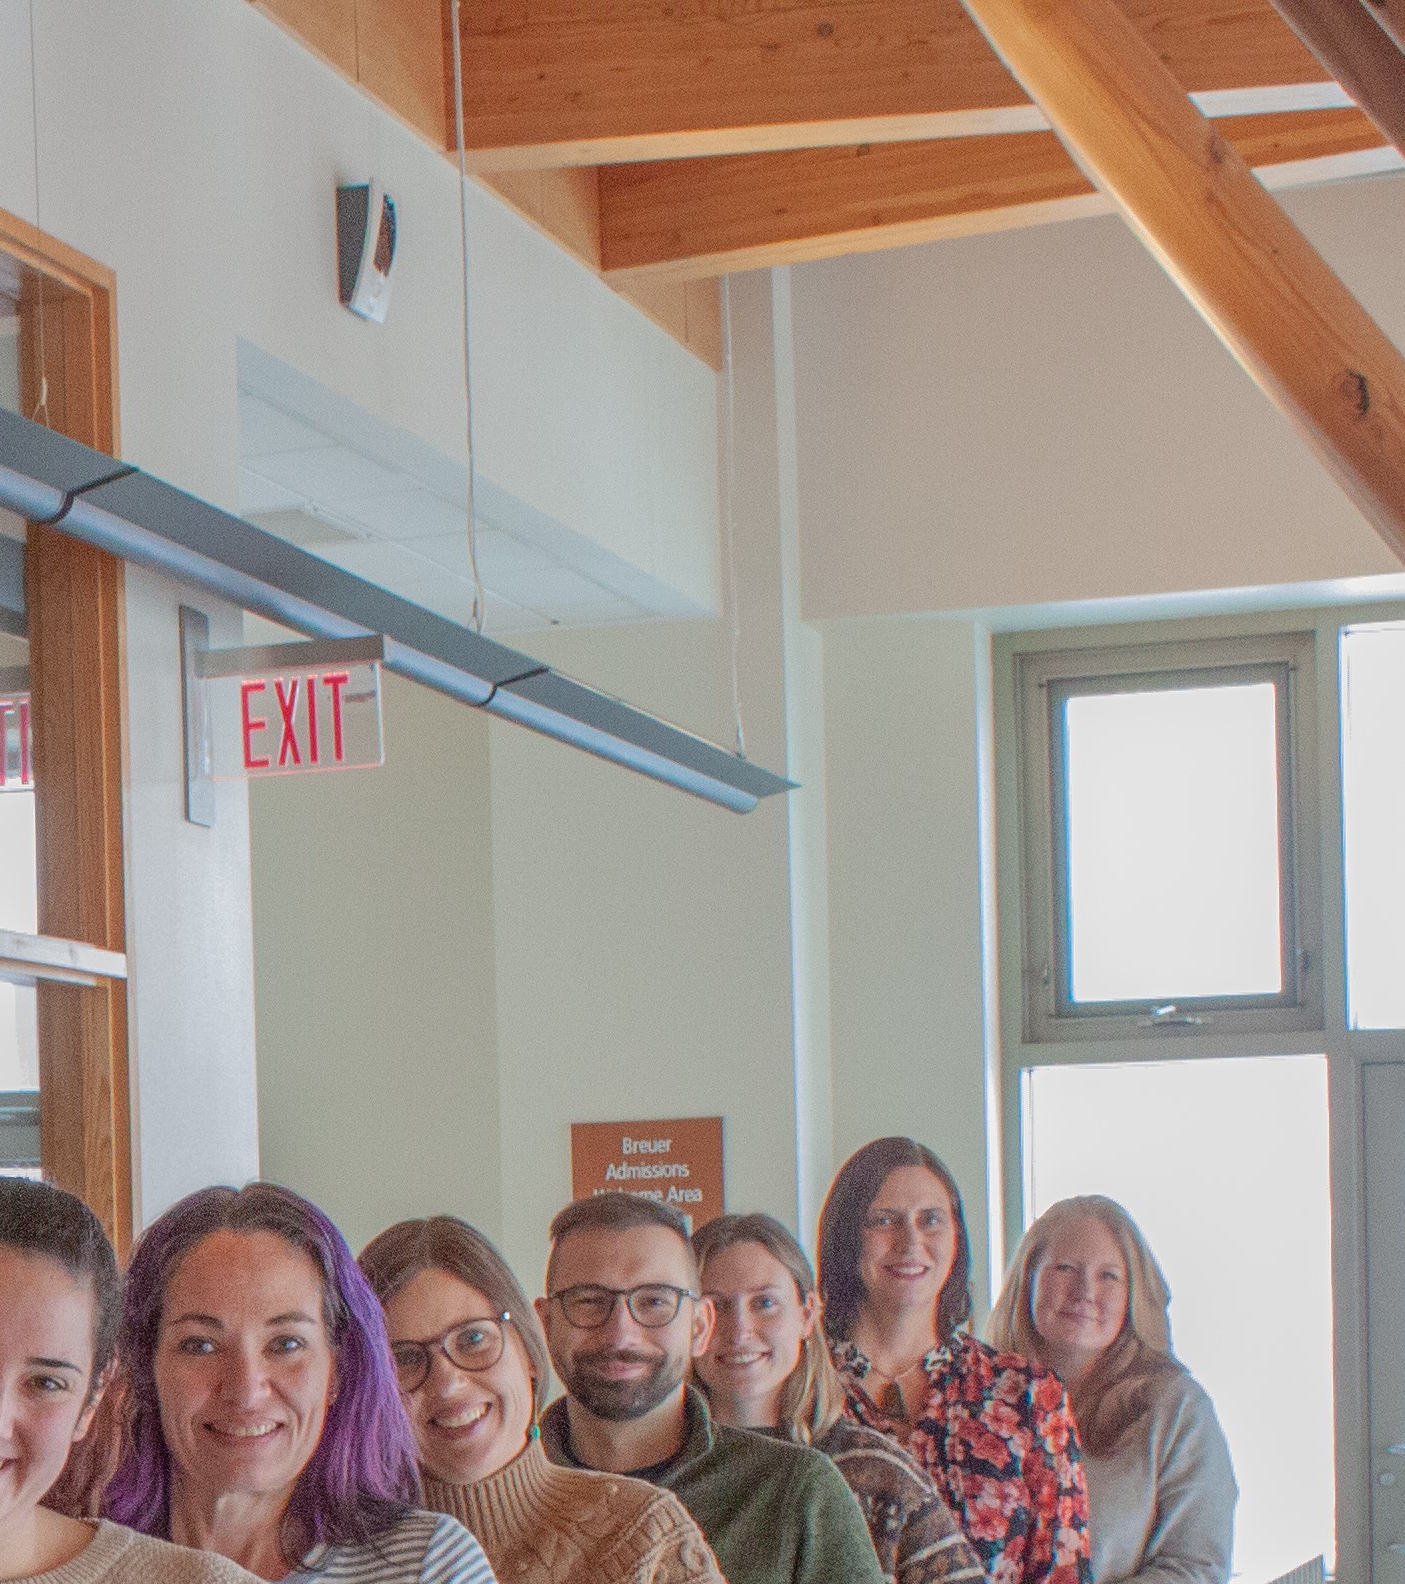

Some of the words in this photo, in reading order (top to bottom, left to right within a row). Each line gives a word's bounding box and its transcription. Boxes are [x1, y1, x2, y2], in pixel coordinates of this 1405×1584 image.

[241, 671, 350, 768] EXIT
[622, 1137, 672, 1155] Breuer
[605, 1162, 690, 1181] Admissions
[666, 1185, 702, 1203] Area
